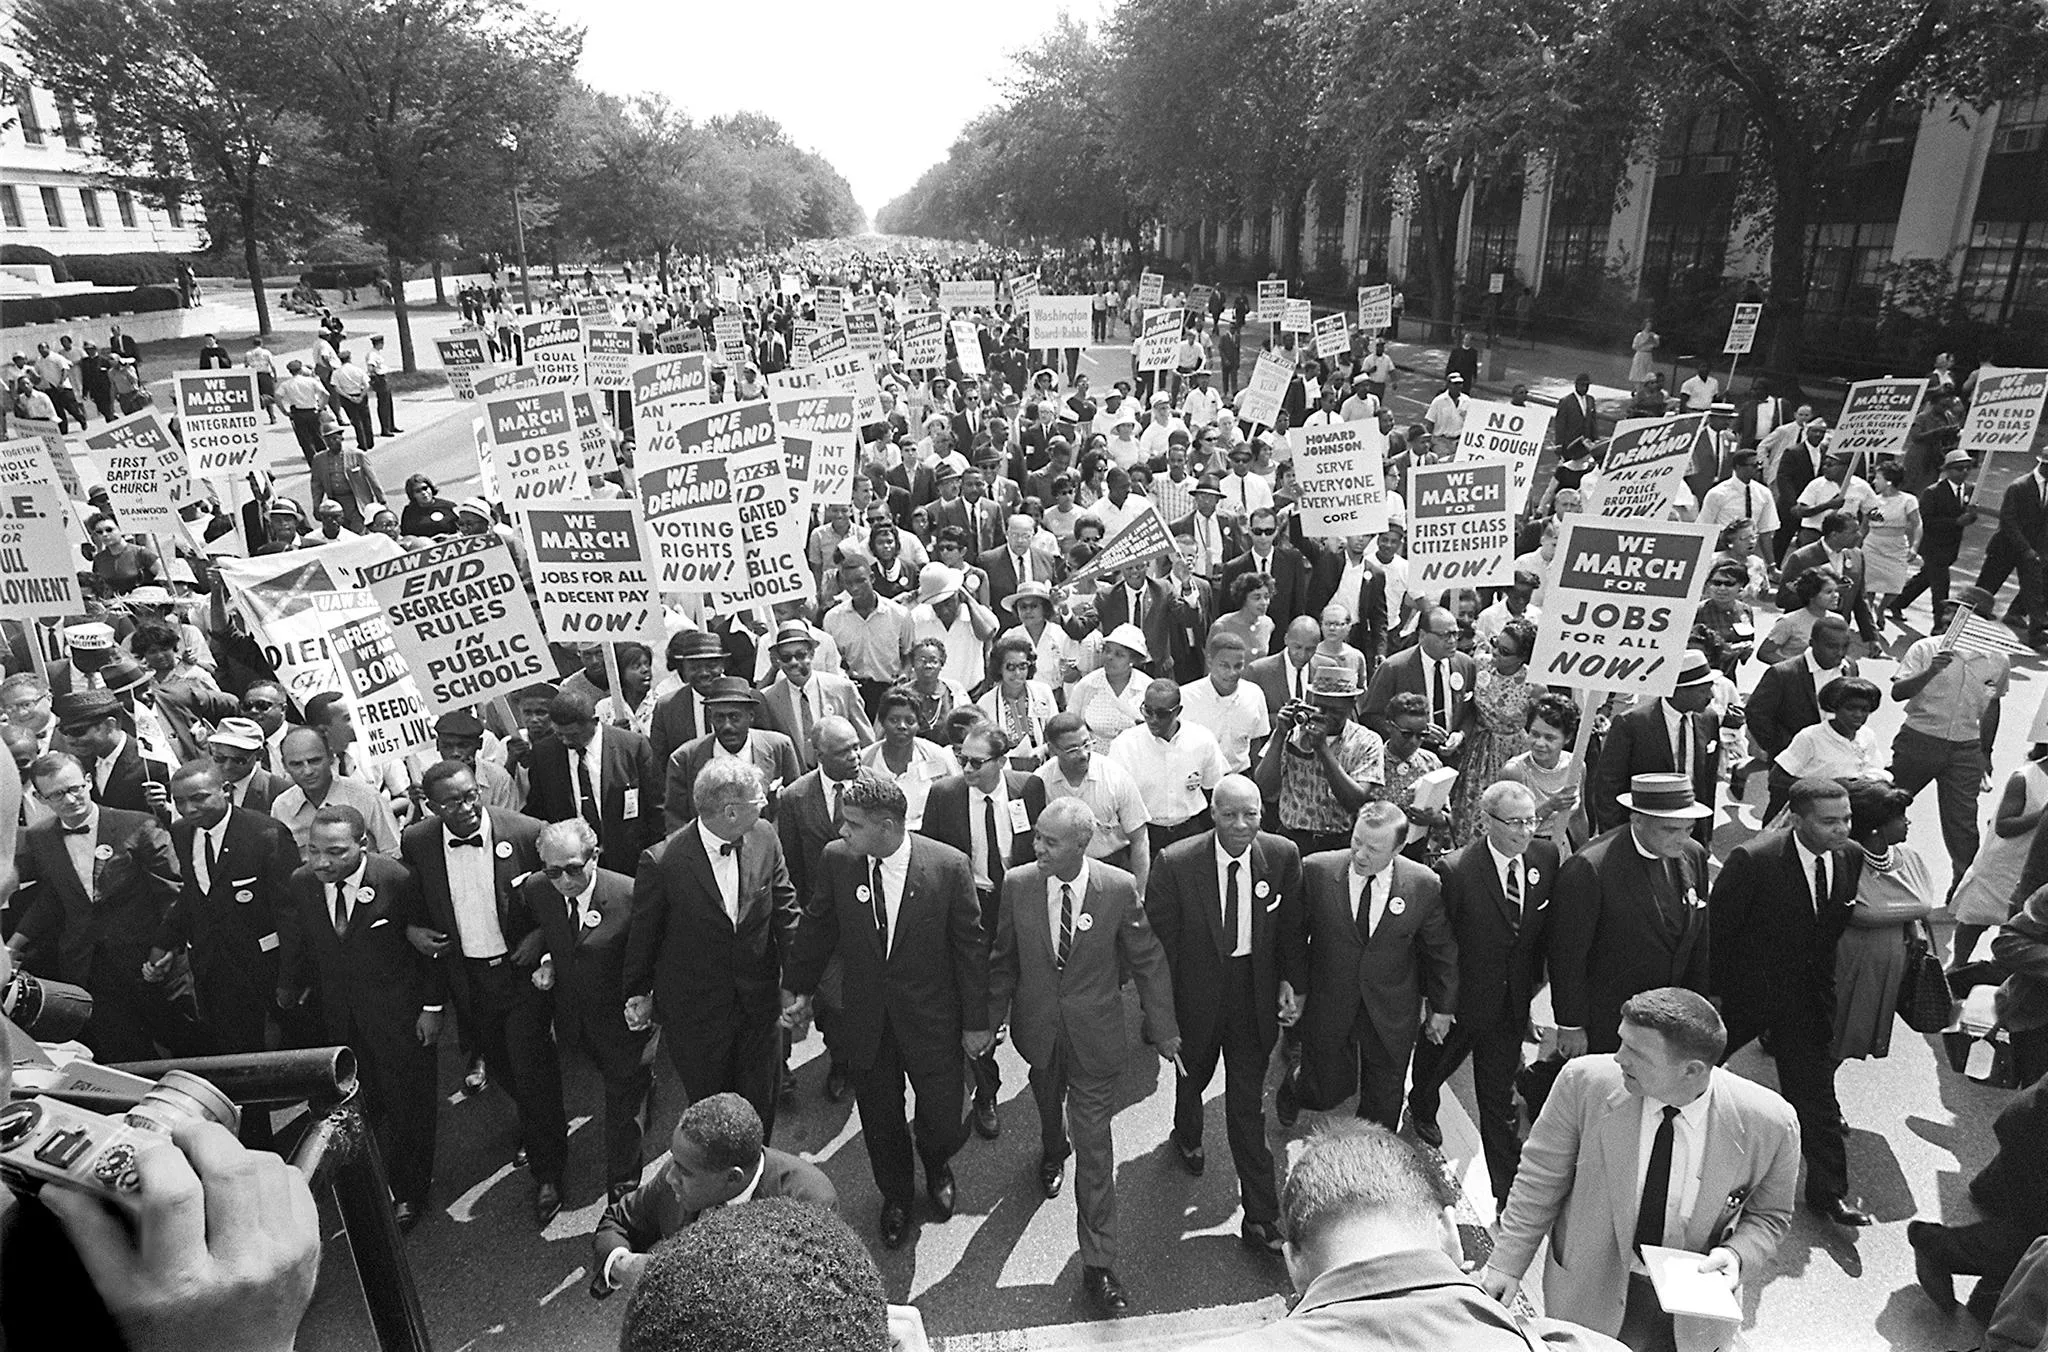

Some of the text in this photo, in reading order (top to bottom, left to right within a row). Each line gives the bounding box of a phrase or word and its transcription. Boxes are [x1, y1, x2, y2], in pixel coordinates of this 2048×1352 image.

[1033, 308, 1088, 325] Washington
[540, 320, 562, 334] WE
[848, 320, 876, 330] MARCH
[906, 321, 941, 339] DEMAND
[1146, 318, 1181, 337] DEMAND
[527, 328, 579, 349] DEMAND
[592, 338, 630, 348] MARCH
[603, 331, 618, 339] WE
[442, 348, 480, 359] MARCH
[450, 341, 465, 350] WE
[665, 342, 689, 354] JOBS
[812, 337, 846, 359] DEMAND
[915, 347, 935, 355] LAW
[1151, 347, 1171, 355] LAW
[534, 352, 577, 362] EQUAL
[911, 353, 942, 365] NOW!
[1145, 354, 1176, 366] NOW!
[538, 364, 580, 373] IGHTS
[656, 361, 682, 380] WE
[825, 360, 864, 380] I.U.E.
[204, 379, 227, 391] WE
[494, 372, 517, 388] WE
[593, 375, 630, 386] NOW!
[639, 370, 702, 401] DEMAND
[2000, 374, 2028, 389] WE
[188, 390, 249, 407] MARCH
[1876, 386, 1897, 395] WE
[1978, 383, 2044, 404] DEMAND
[516, 399, 541, 413] WE
[797, 399, 829, 417] WE
[1853, 394, 1912, 407] MARCH
[207, 405, 232, 413] FOR
[641, 405, 664, 418] AN
[1977, 407, 2036, 419] AN END
[187, 416, 258, 432] INTEGRATED
[498, 408, 564, 432] MARCH
[707, 411, 741, 438] WE
[1488, 412, 1525, 432] NO
[1839, 420, 1909, 431] CIVIL RIGHTS
[1849, 413, 1907, 422] EFFECTIVE
[1977, 419, 2031, 431] TO BIAS
[110, 426, 134, 442] WE
[521, 427, 548, 438] FOR
[688, 422, 772, 454] DEMAND
[1305, 430, 1356, 445] HOWARD
[1638, 423, 1676, 446] WE
[1853, 428, 1885, 436] LAWS
[1970, 431, 2029, 445] NOW!
[190, 432, 260, 449] SCHOOLS
[1463, 432, 1538, 457] U.S. DOUGH
[1838, 436, 1899, 449] NOW!
[2, 445, 41, 458] TOGETHER
[199, 446, 259, 470] NOW!
[506, 440, 570, 468] JOBS
[1608, 432, 1692, 470] DEMAND
[110, 456, 148, 468] FIRST
[1316, 459, 1354, 474] SERVE
[106, 469, 157, 482] BAPTIST
[511, 462, 571, 479] FOR ALL
[666, 464, 699, 490] WE
[1610, 466, 1674, 482] AN END
[515, 471, 577, 499] NOW!
[1302, 474, 1375, 492] EVERYONE
[1447, 472, 1474, 487] WE
[111, 482, 158, 494] CHURCH
[1421, 484, 1499, 506] MARCH
[1618, 482, 1657, 495] POLICE
[647, 478, 728, 515] DEMAND
[1301, 491, 1381, 509] EVERYWHERE
[1603, 492, 1661, 506] BRUTALITY
[120, 506, 169, 516] DEANWOOD
[1445, 504, 1476, 514] FOR
[1601, 497, 1668, 518] NOW!
[563, 514, 597, 529] WE
[1323, 511, 1358, 524] CORE
[3, 523, 24, 531] CIO
[651, 521, 734, 538] VOTING
[1415, 518, 1506, 538] FIRST CLASS
[541, 531, 630, 549] MARCH
[1411, 535, 1509, 555] CITIZENSHIP
[1617, 535, 1657, 554] WE
[372, 553, 421, 581] UAW
[428, 536, 496, 564] SAYS:
[570, 551, 606, 560] FOR
[660, 543, 733, 559] RIGHTS
[662, 559, 735, 582] NOW!
[1422, 555, 1502, 581] NOW!
[1572, 552, 1687, 581] MARCH
[402, 558, 485, 599] END
[540, 570, 647, 584] JOBS FOR ALL
[1603, 579, 1647, 592] FOR
[388, 573, 516, 626] SEGREGATED
[544, 590, 649, 603] A DECENT PAY
[415, 599, 506, 642] RULES
[561, 609, 648, 632] NOW!
[1561, 601, 1672, 633] JOBS
[1560, 631, 1660, 650] FOR ALL
[427, 634, 530, 680] PUBLIC
[351, 652, 410, 694] BORN
[1548, 651, 1665, 682] NOW!
[433, 655, 543, 704] SCHOOLS
[368, 728, 385, 741] WE
[368, 737, 400, 757] MUST
